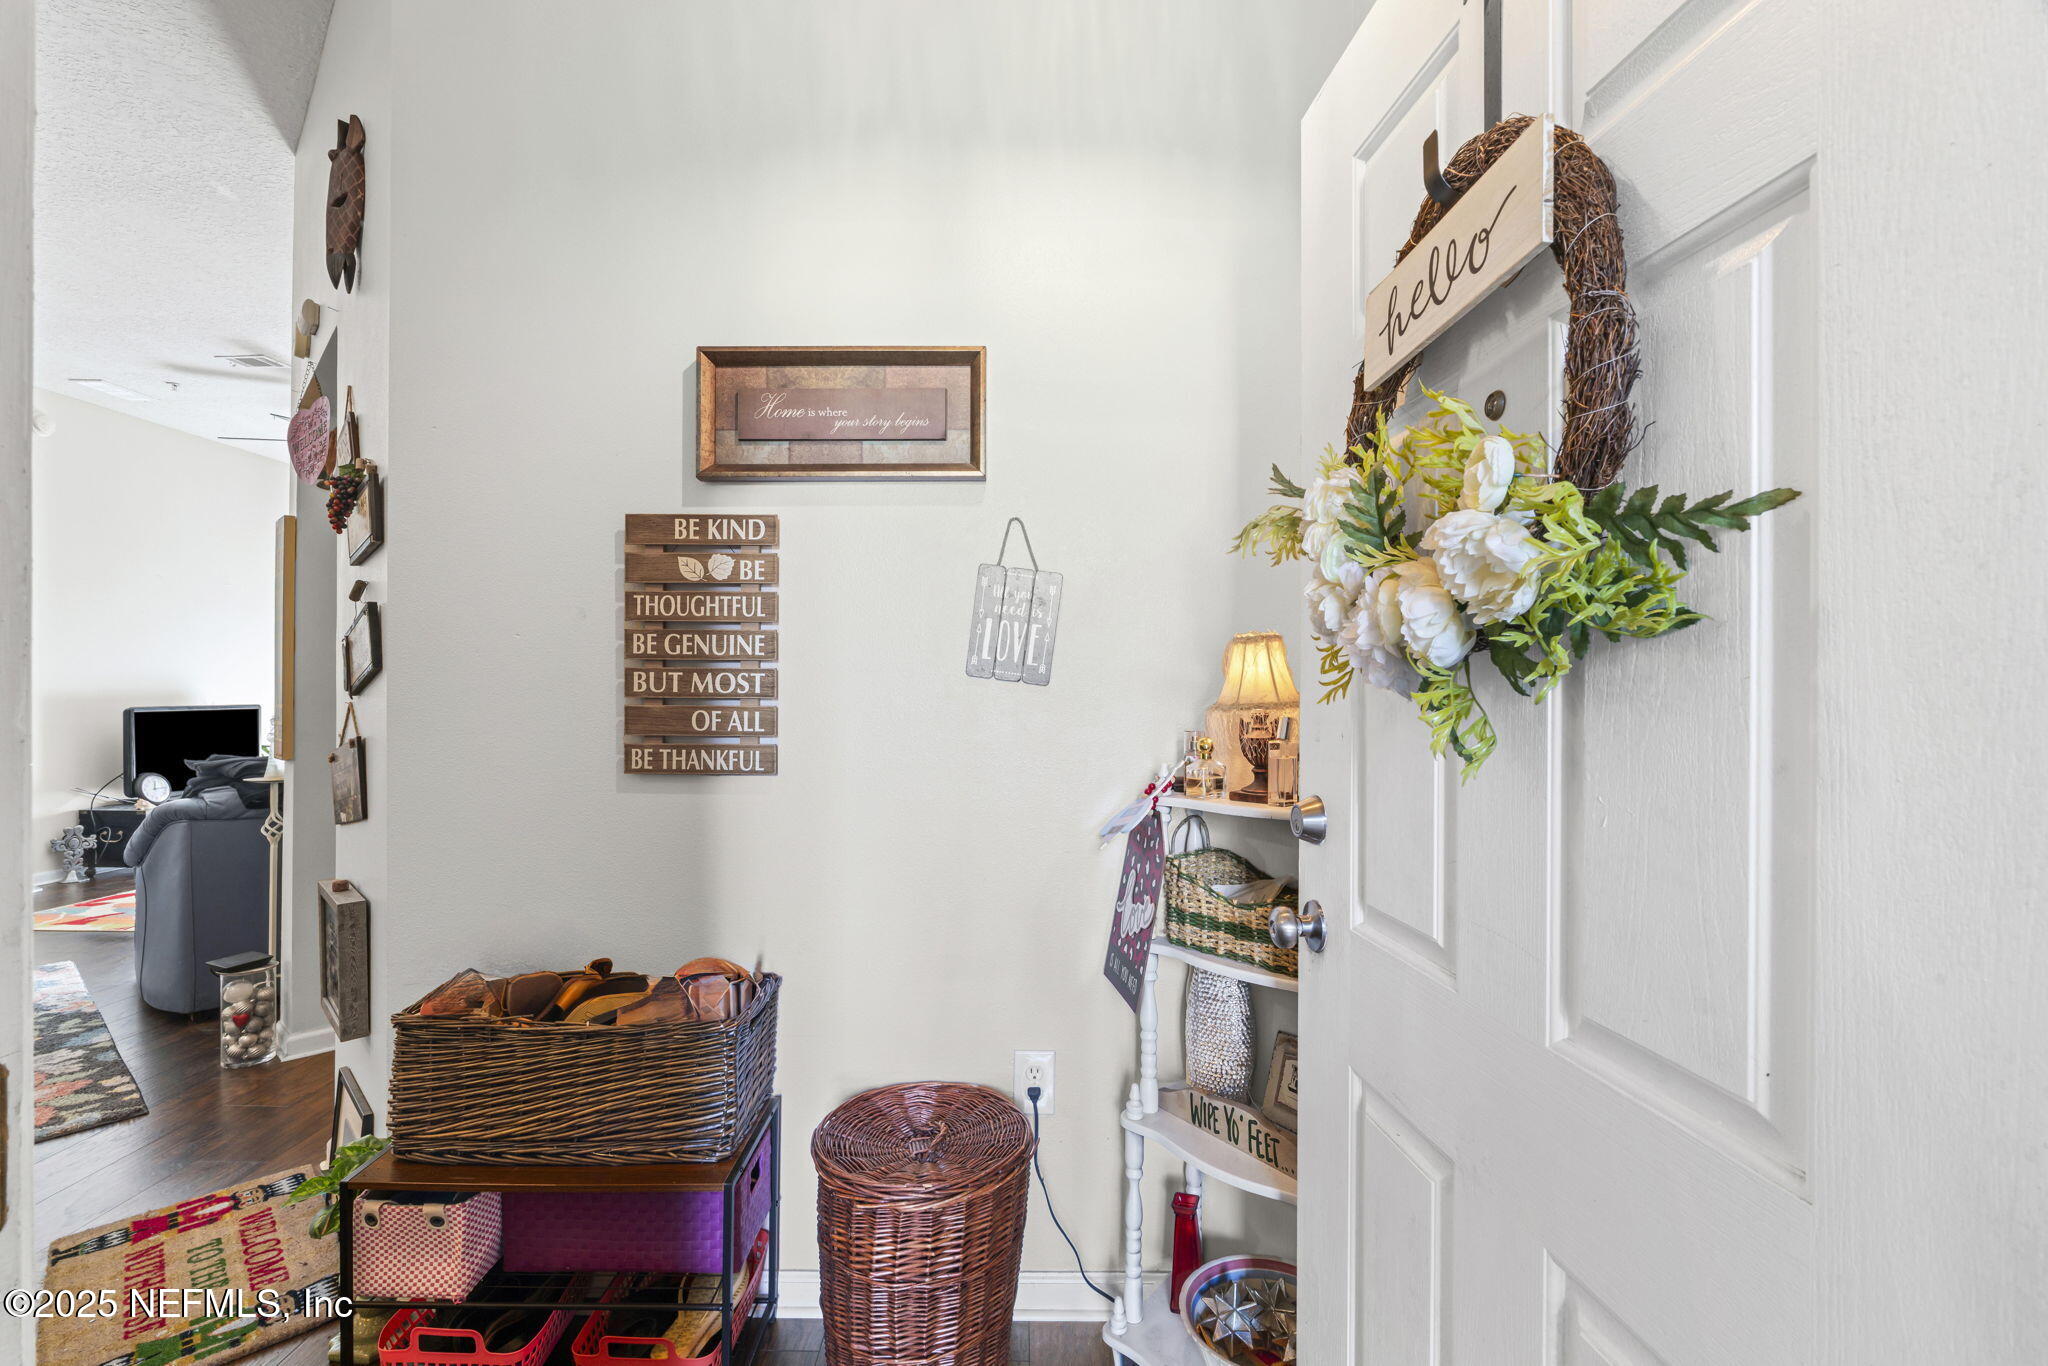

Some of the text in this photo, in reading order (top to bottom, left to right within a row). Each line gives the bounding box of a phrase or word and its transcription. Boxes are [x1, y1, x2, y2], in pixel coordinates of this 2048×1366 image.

[1379, 184, 1517, 356] hello
[754, 392, 848, 419] Home is where
[830, 412, 930, 434] your story begins
[674, 518, 766, 540] BE KIND
[739, 559, 765, 581] BE
[633, 595, 766, 617] THOUGHTFUL
[1013, 590, 1032, 604] you
[994, 602, 1042, 618] need is
[632, 633, 765, 656] BE GENUINE
[981, 617, 1043, 666] LOVE
[633, 671, 765, 694] BUT MOST
[691, 710, 765, 732] OF ALL
[631, 748, 765, 771] BE THANKFUL
[1189, 1092, 1220, 1135] WIPE
[186, 1237, 225, 1264] TO
[239, 1207, 290, 1292] WELCOME
